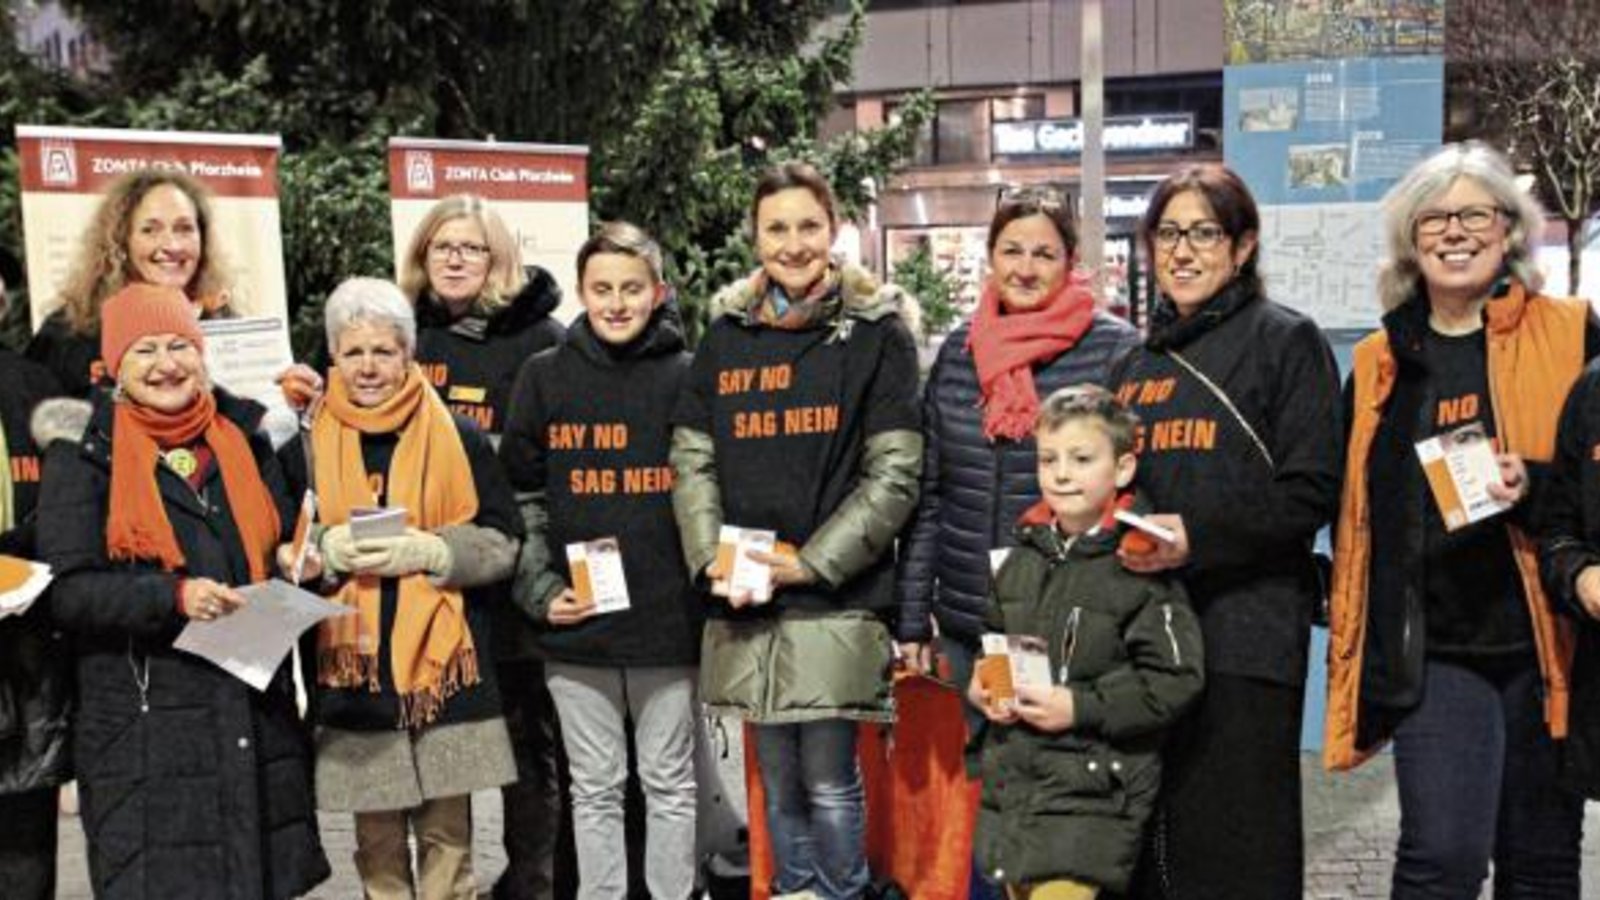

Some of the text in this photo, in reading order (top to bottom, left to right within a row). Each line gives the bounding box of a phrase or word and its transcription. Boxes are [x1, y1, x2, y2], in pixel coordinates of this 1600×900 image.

[92, 158, 147, 173] ZONTA
[445, 166, 488, 181] ZONTA
[718, 363, 792, 395] SAY NO
[1138, 377, 1177, 405] NO
[734, 404, 839, 439] SAG NEIN
[1438, 394, 1479, 426] NO
[549, 423, 628, 450] SAY NO
[1152, 419, 1217, 451] NEIN
[570, 469, 616, 494] SAG
